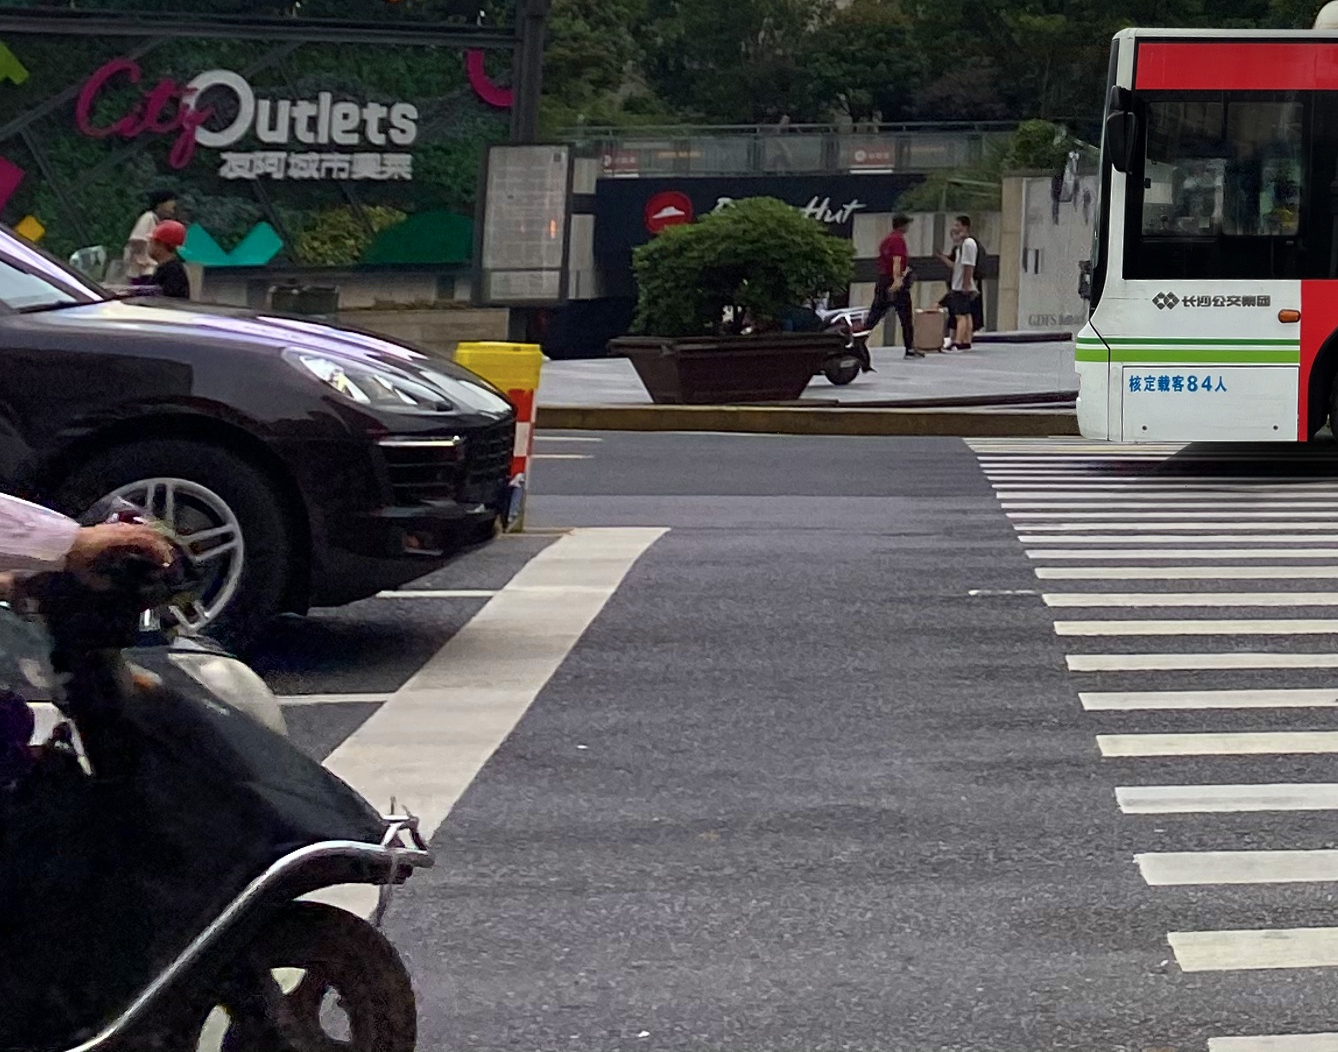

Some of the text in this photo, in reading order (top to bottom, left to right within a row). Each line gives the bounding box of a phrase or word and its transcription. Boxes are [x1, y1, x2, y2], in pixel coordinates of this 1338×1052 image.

[801, 195, 868, 225] Hut
[1181, 295, 1272, 308] 长沙公交集团
[1128, 374, 1228, 393] 核定载客84人
